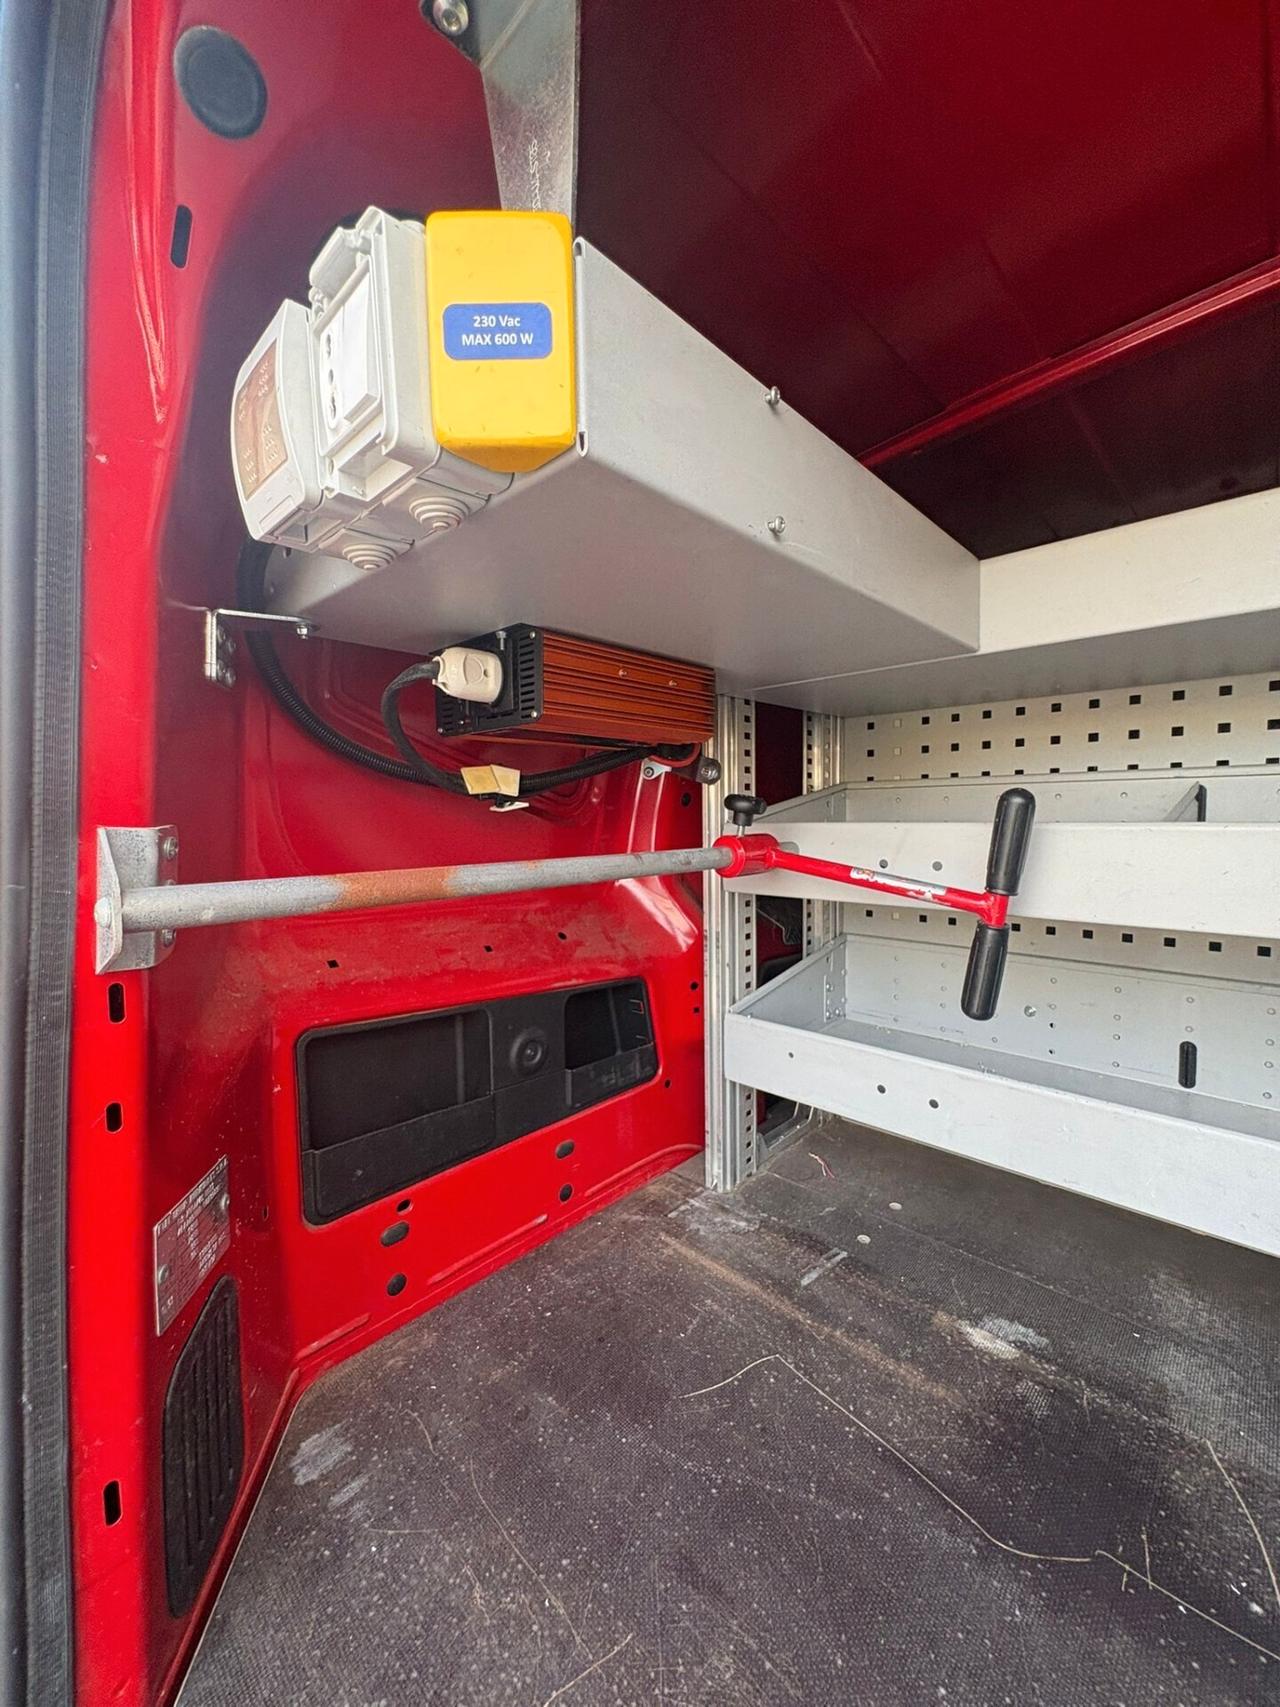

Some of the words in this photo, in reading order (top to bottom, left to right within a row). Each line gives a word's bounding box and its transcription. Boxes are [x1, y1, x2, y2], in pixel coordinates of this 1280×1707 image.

[473, 315, 496, 328] 230
[499, 315, 521, 327] Vac
[461, 334, 492, 346] MAX
[494, 333, 517, 345] 600
[520, 333, 534, 345] W
